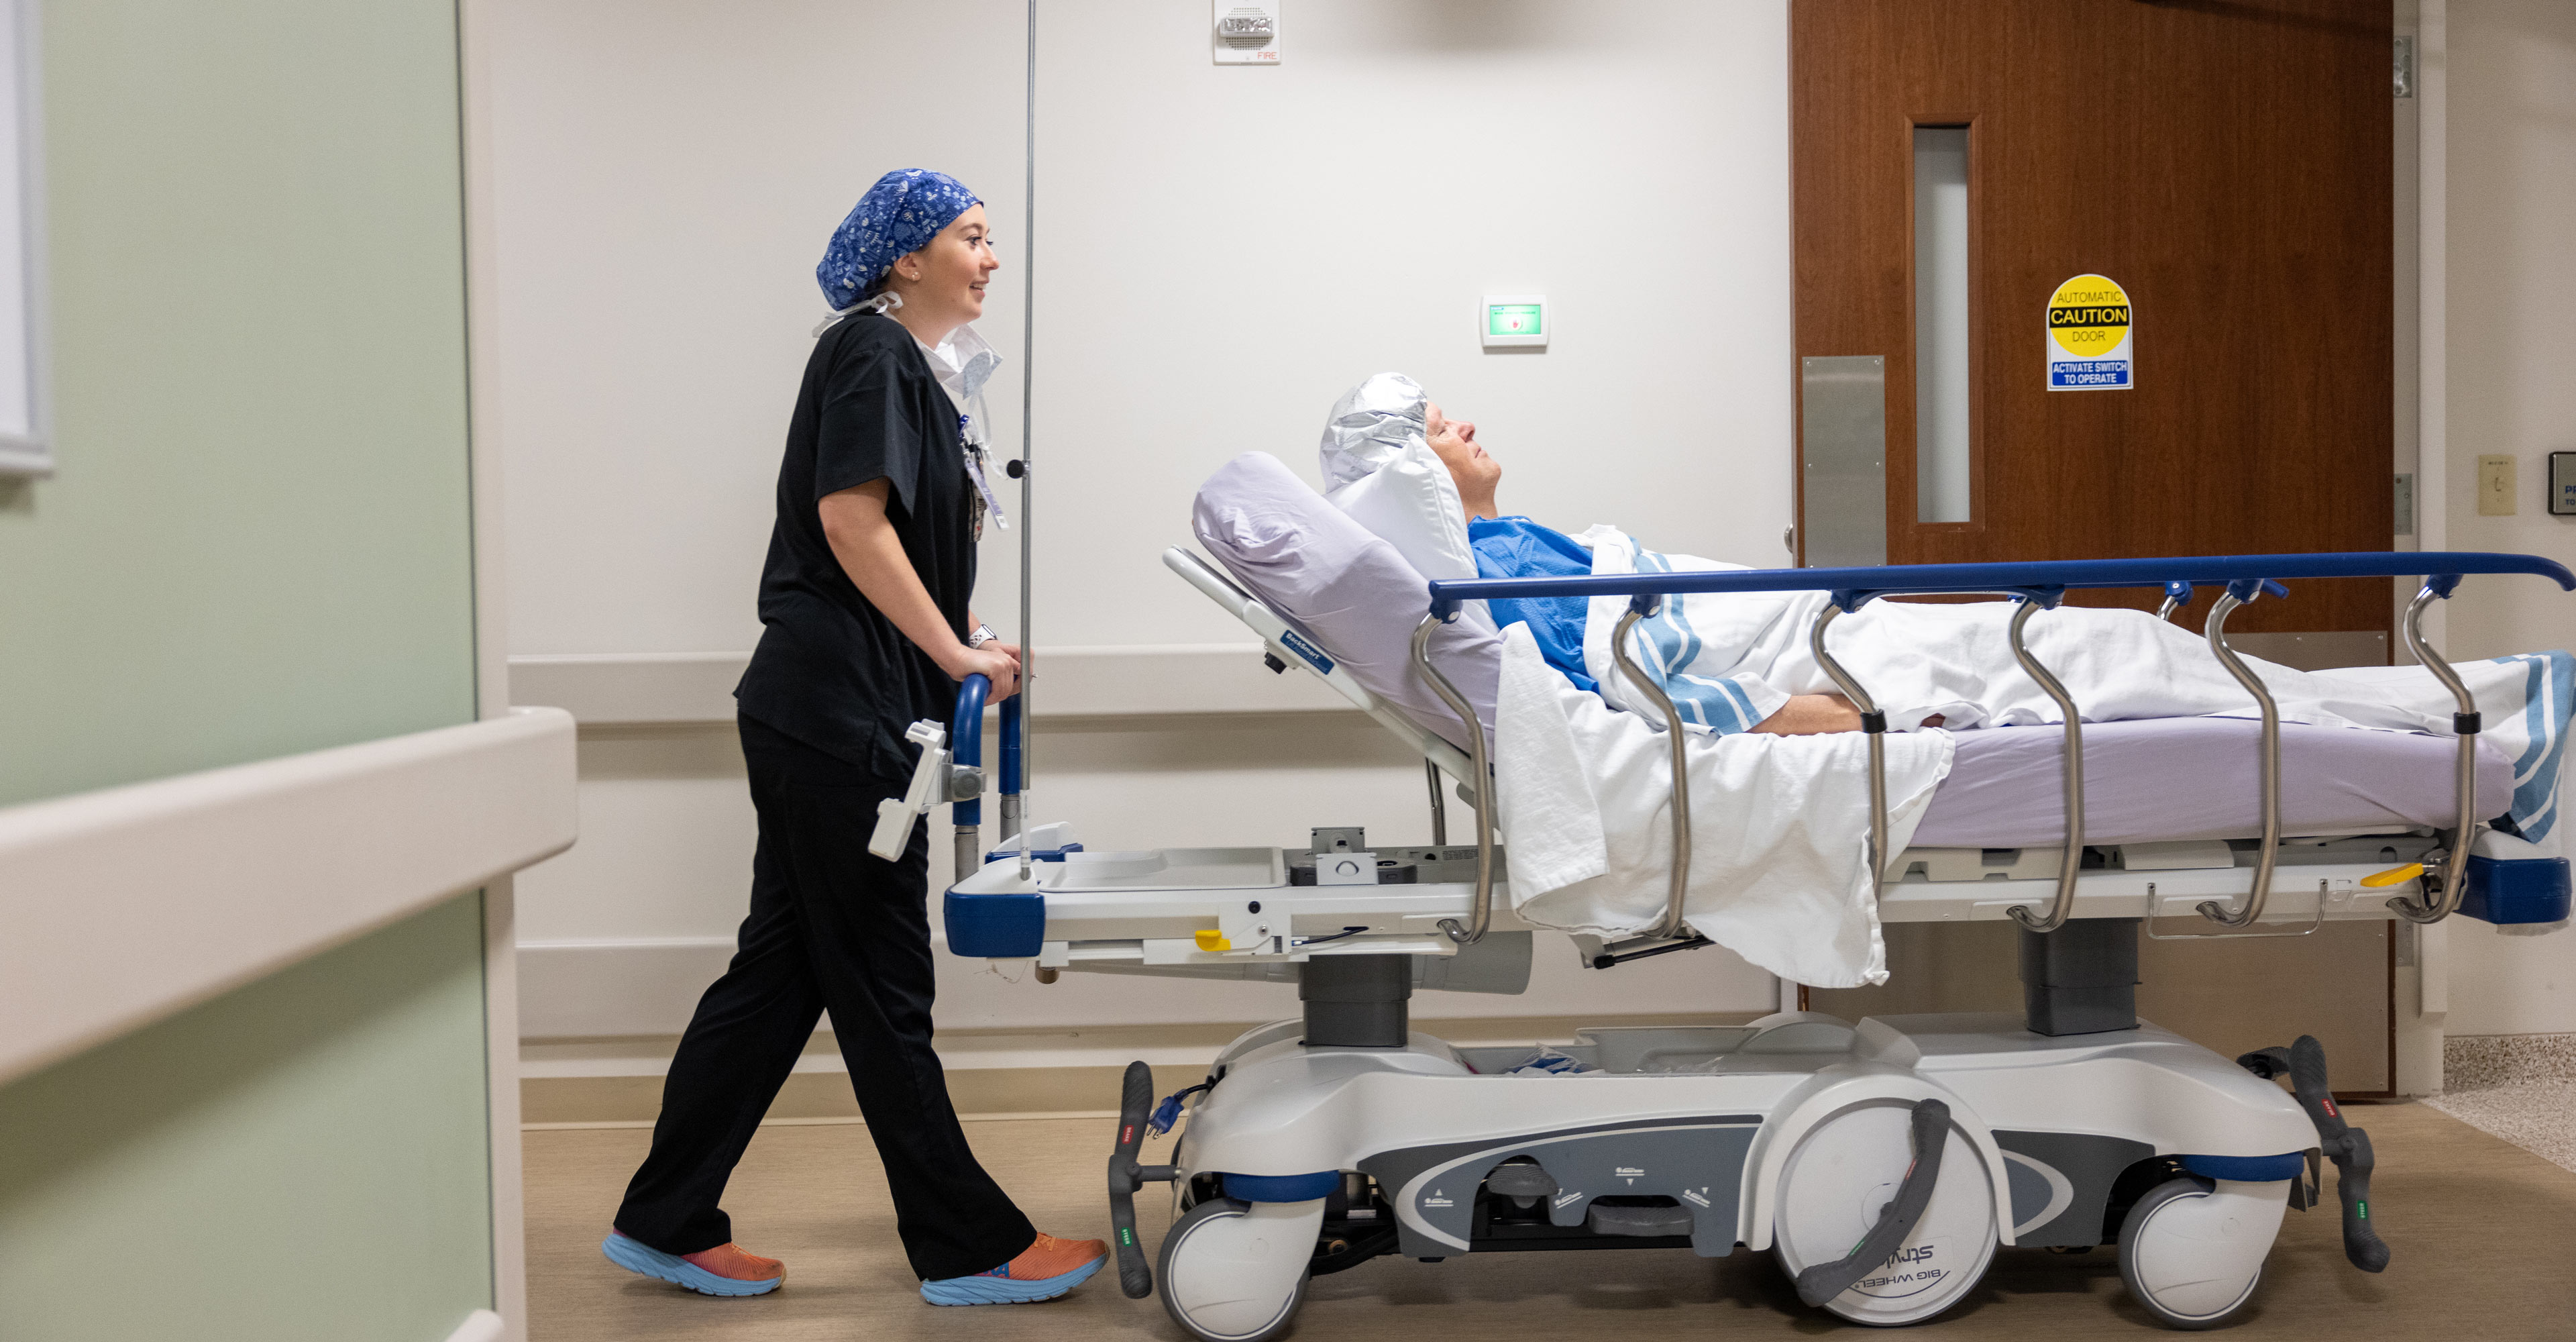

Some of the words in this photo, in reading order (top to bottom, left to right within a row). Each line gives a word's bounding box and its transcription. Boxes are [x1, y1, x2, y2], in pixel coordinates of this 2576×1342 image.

[1258, 52, 1277, 60] FIRE
[2057, 291, 2122, 303] AUTOMATIC
[2051, 308, 2128, 325] CAUTION
[2072, 331, 2106, 342] DOOR
[2053, 362, 2094, 373] ACTIVATE
[2094, 362, 2127, 372] SWITCH
[2064, 374, 2076, 384] TO
[2078, 373, 2117, 384] OPERATE
[1286, 633, 1320, 660] BackSmart
[1122, 1229, 1130, 1245] STEER
[1917, 1269, 1941, 1280] BIG
